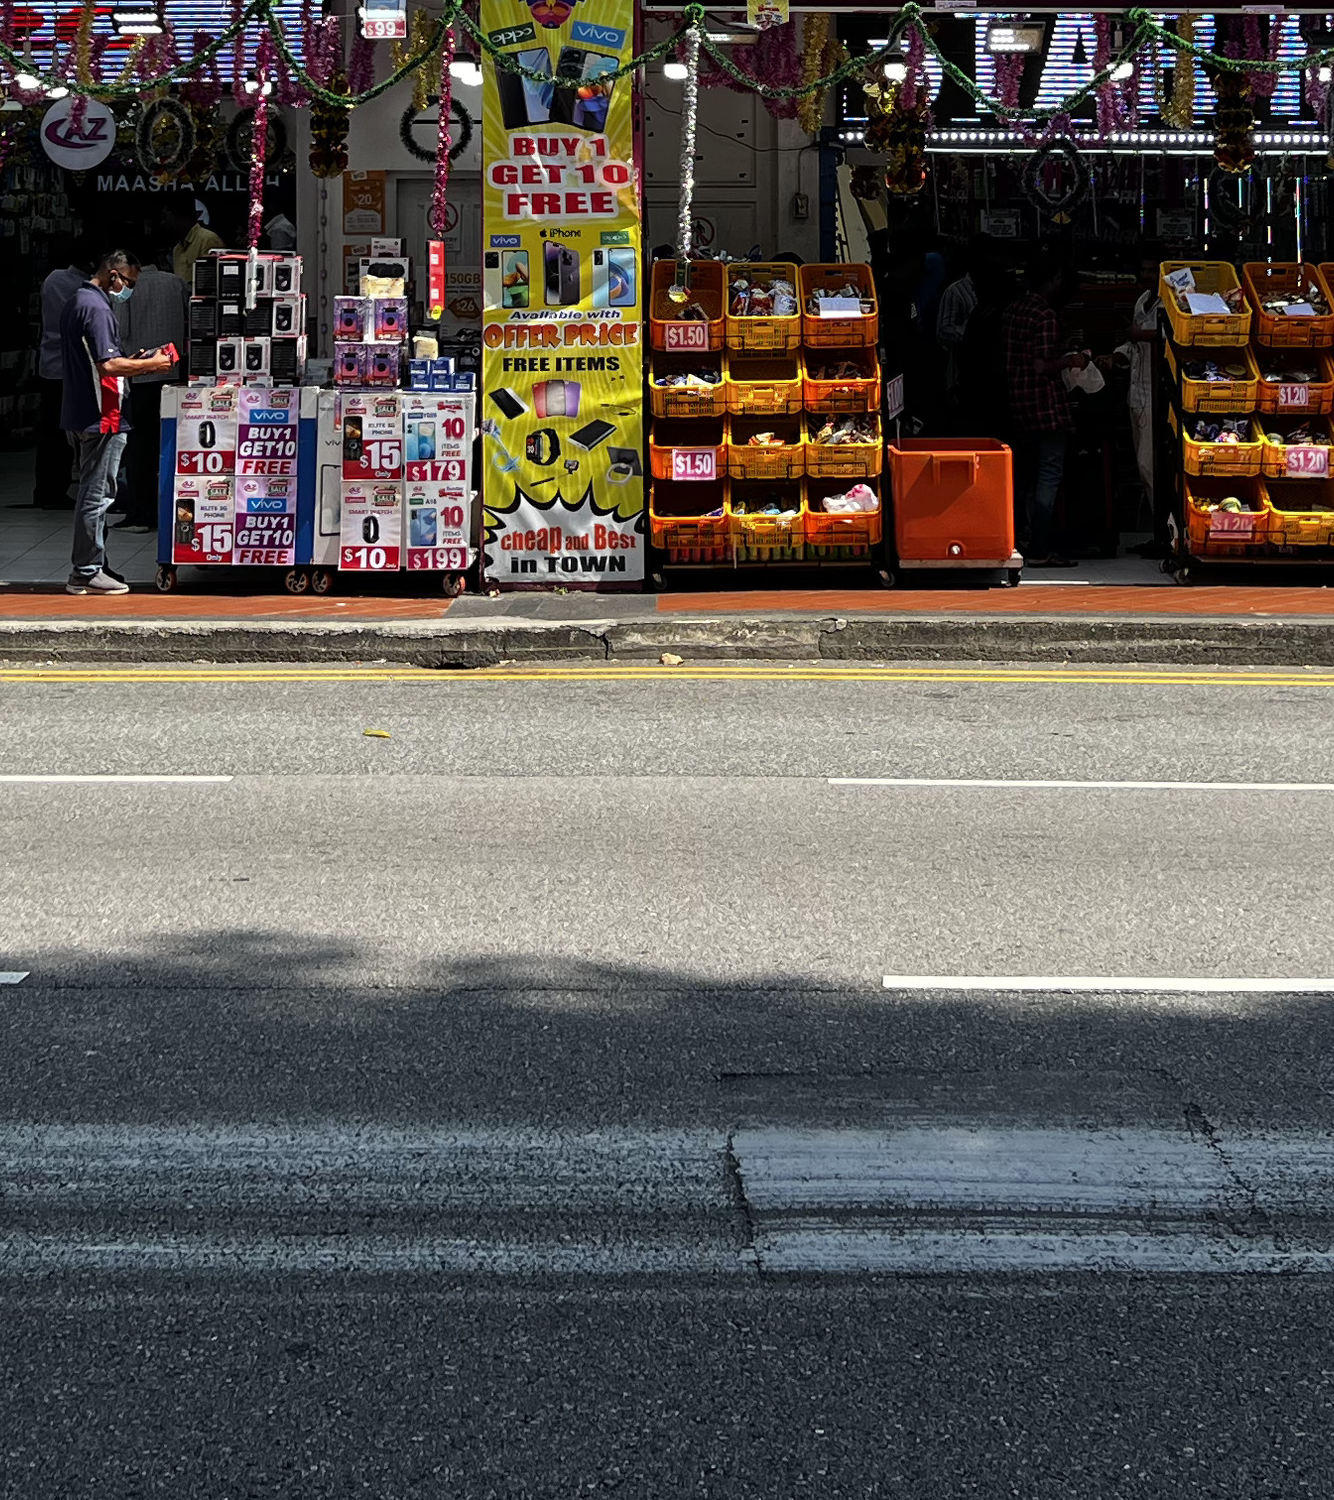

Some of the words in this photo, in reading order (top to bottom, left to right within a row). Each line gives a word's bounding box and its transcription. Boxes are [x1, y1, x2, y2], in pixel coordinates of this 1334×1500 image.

[366, 22, 396, 36] $99
[491, 26, 532, 44] oppo
[577, 25, 619, 42] vivo
[513, 137, 581, 157] BUY
[586, 137, 606, 157] 1
[492, 165, 566, 184] GET
[578, 164, 629, 184] 10
[204, 175, 280, 192] ALLH
[507, 192, 614, 215] FREE
[492, 236, 518, 245] vivo
[510, 310, 583, 321] Available
[587, 309, 620, 319] with
[484, 324, 562, 348] OFFER
[669, 325, 705, 346] $1.50
[503, 357, 550, 372] FREE
[555, 356, 620, 371] ITEMS
[1279, 388, 1306, 404] $1.20
[253, 411, 285, 421] vivo
[247, 427, 292, 440] BUY1
[442, 418, 466, 438] 10
[239, 441, 296, 457] GET10
[359, 440, 401, 470] $15
[180, 452, 224, 473] $10
[242, 460, 292, 474] FREE
[412, 461, 461, 481] $179
[675, 453, 713, 476] $1.50
[1288, 453, 1324, 471] $1.20
[251, 499, 283, 509] vivo
[244, 516, 289, 528] BUY1
[440, 506, 464, 527] 10
[190, 524, 232, 553] $15
[237, 530, 294, 546] GET10
[500, 526, 562, 554] cheap
[594, 524, 637, 550] Best
[239, 550, 289, 564] FREE
[344, 547, 386, 569] $10
[413, 549, 462, 569] $199
[511, 557, 537, 573] in
[544, 556, 626, 573] TOWN
